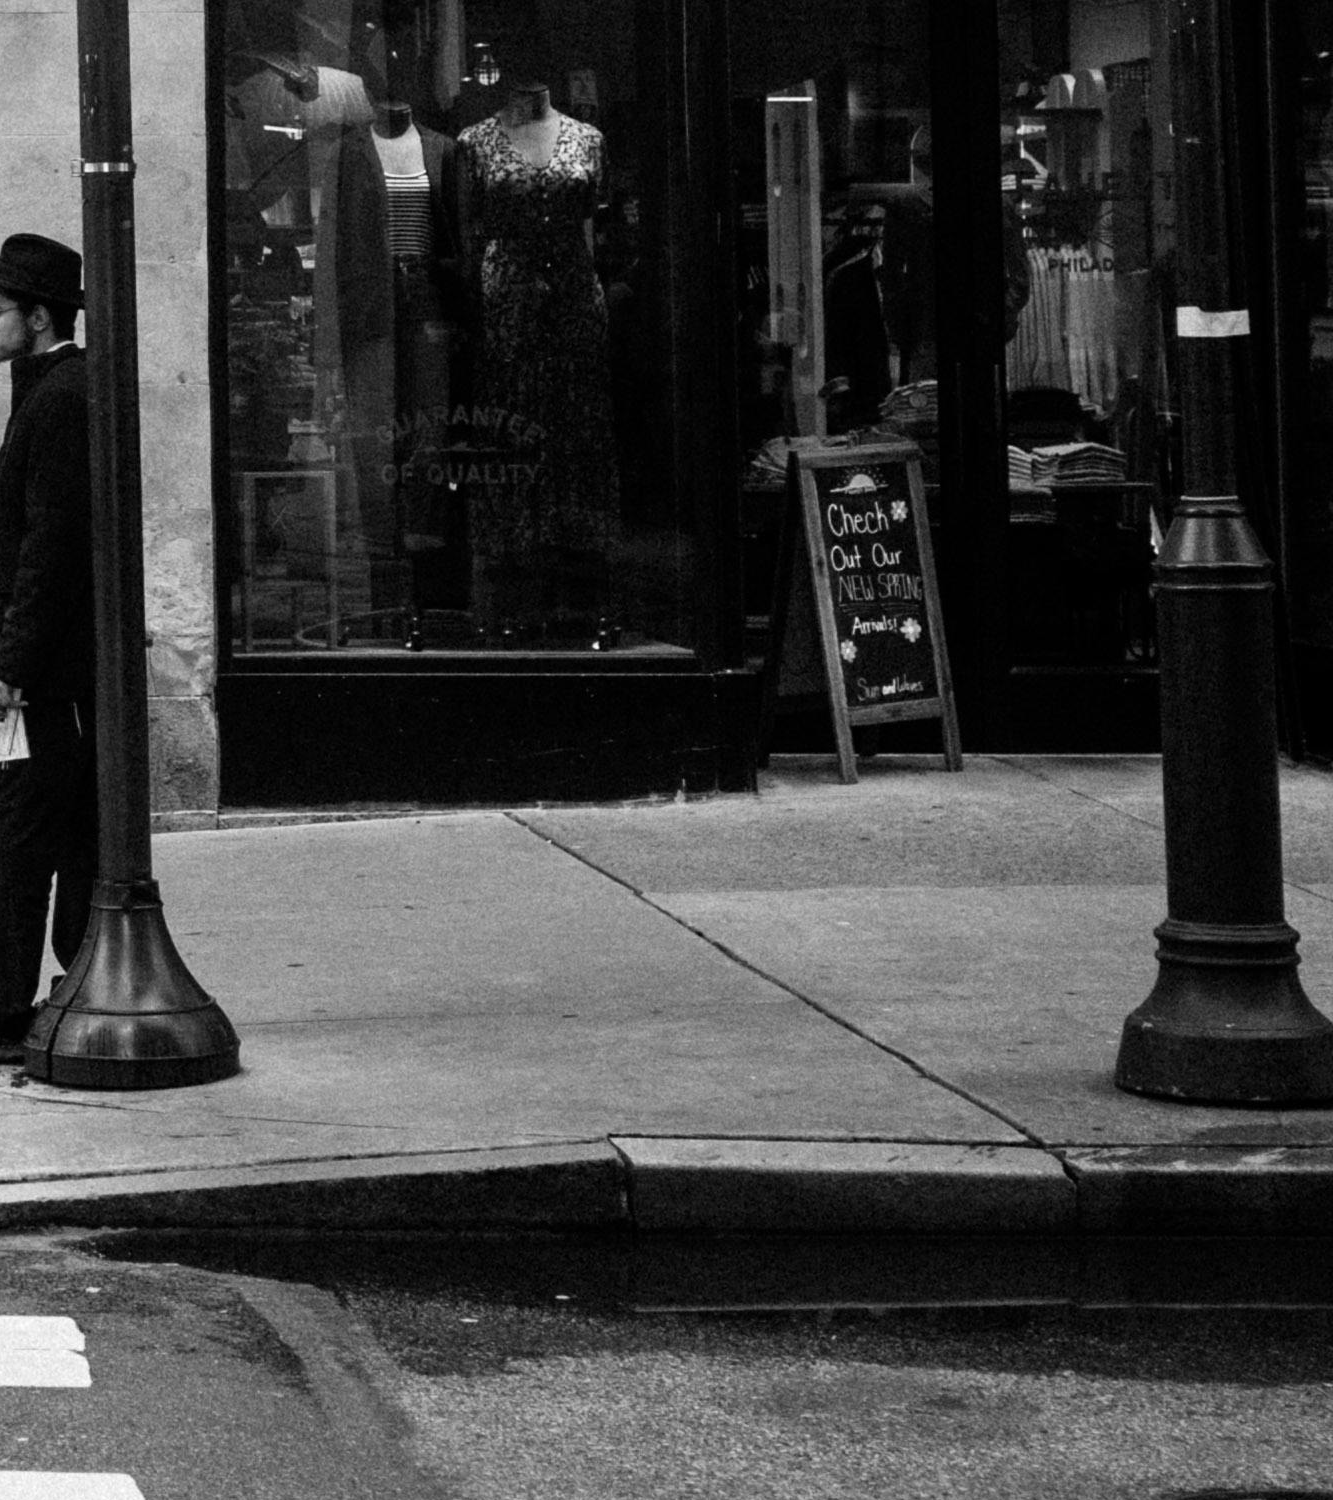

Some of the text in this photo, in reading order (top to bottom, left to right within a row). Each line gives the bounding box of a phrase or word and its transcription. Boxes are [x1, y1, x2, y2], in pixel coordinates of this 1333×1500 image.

[381, 464, 541, 486] OF QUALITY
[830, 543, 903, 571] Out Our
[839, 573, 922, 602] NEW SPRING
